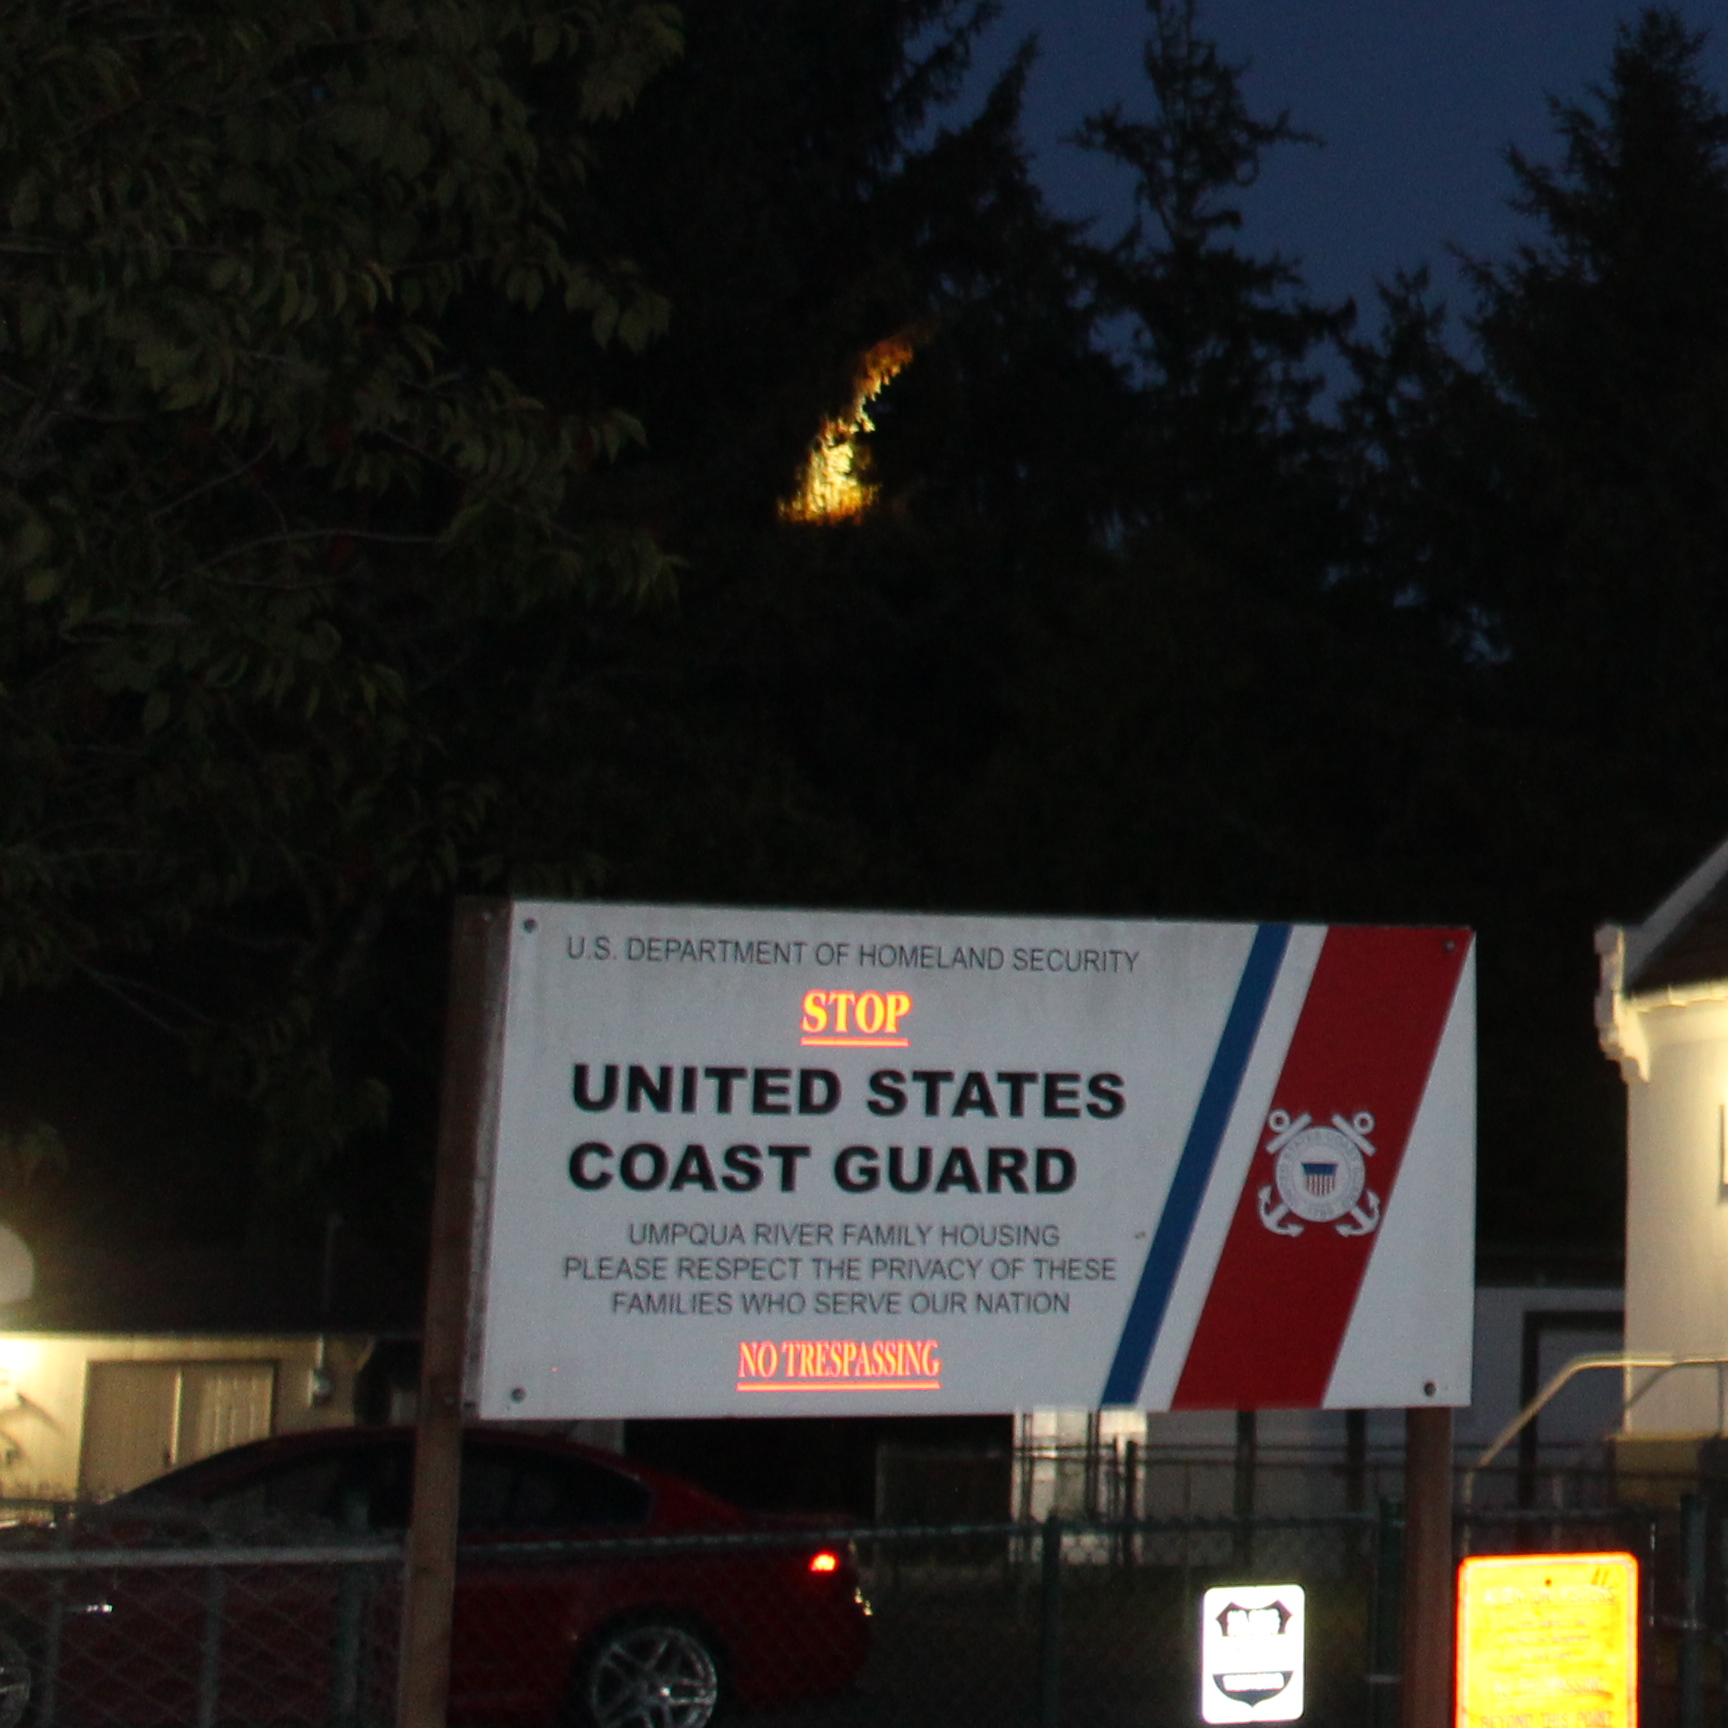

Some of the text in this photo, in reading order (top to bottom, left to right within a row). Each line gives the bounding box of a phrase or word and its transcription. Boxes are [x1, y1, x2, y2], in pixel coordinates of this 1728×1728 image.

[567, 936, 1139, 973] U.S. DEPARTMENT OF HOMELAND SECURITY
[801, 989, 912, 1034] STOP
[573, 1063, 1126, 1120] UNITED STATES
[569, 1141, 1077, 1194] COAST GUARD
[629, 1222, 1061, 1247] UMPQUA RIVER FAMILY HOUSING
[563, 1256, 1117, 1281] PLEASE RESPECT THE PRIVACY OF THESE
[611, 1291, 1070, 1315] FAMILIES WHO SERVE OUR NATION
[738, 1339, 942, 1379] NO TRESPASSING
